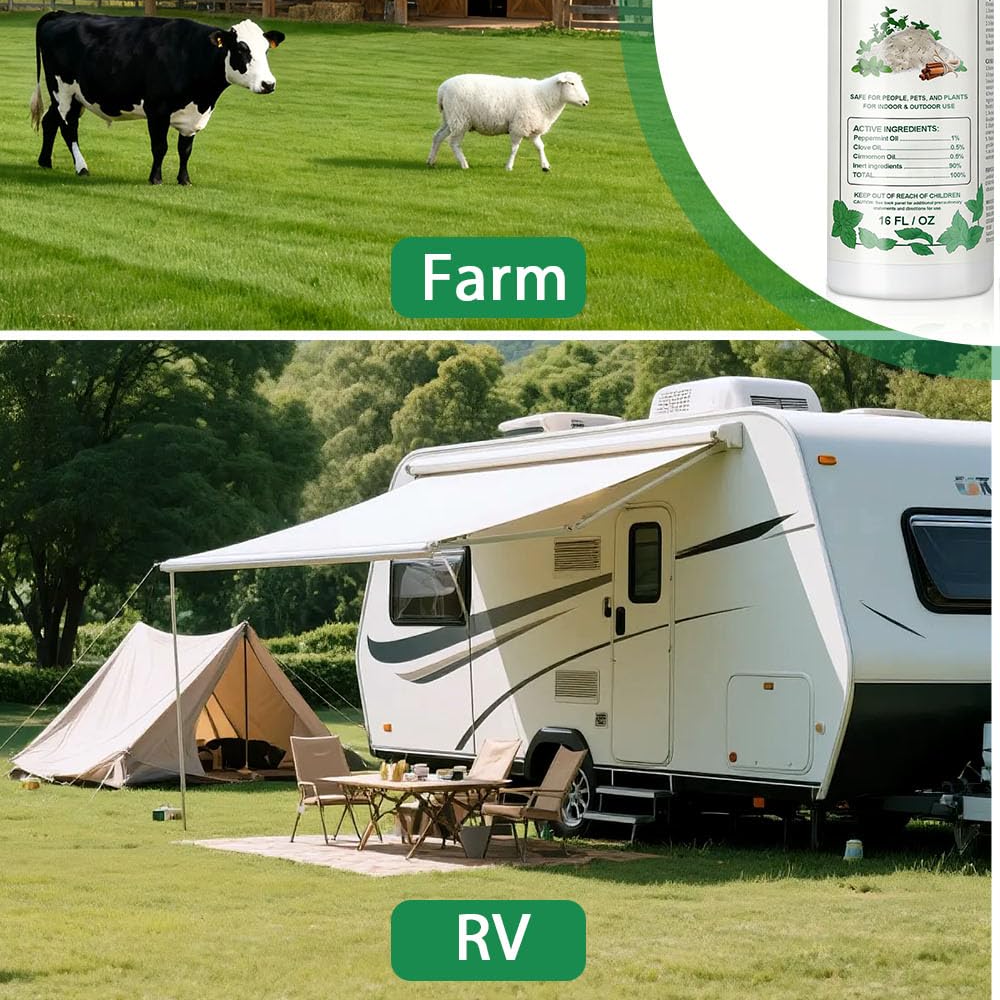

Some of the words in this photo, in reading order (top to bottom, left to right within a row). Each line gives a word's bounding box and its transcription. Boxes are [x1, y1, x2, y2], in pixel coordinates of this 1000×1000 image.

[853, 125, 882, 133] ACTIVE
[883, 125, 940, 133] INGREDIENTS:
[853, 135, 889, 143] Peppermint
[879, 216, 891, 226] 16
[894, 216, 909, 226] FL
[918, 216, 936, 226] OZ
